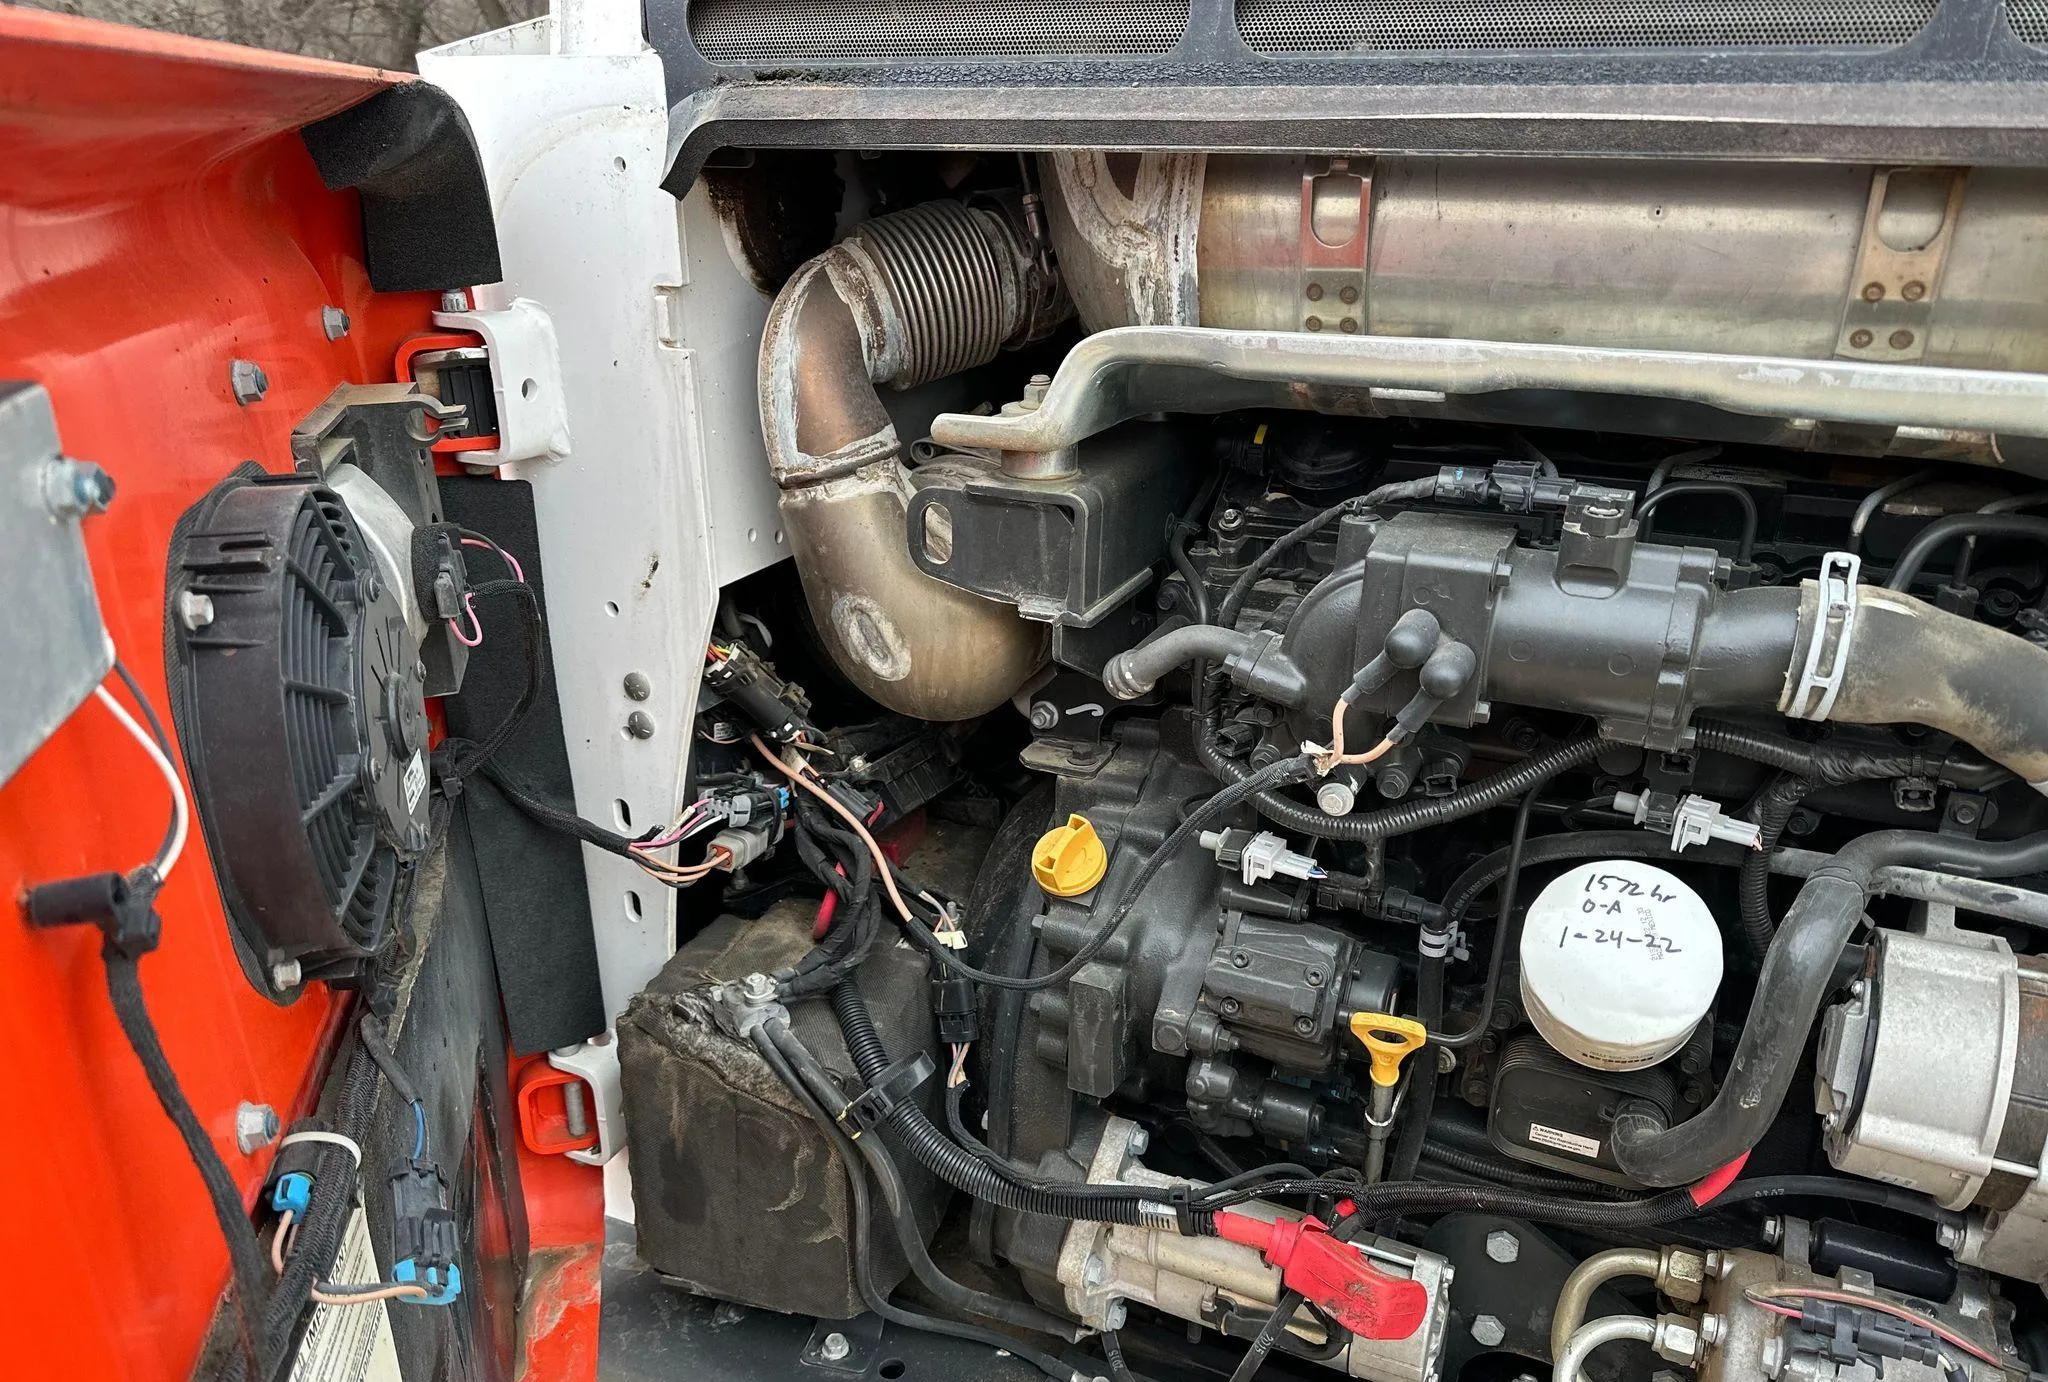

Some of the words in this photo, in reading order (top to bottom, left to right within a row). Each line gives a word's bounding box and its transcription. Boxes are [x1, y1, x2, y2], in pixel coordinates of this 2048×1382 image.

[1585, 874, 1644, 896] 1572
[1650, 884, 1677, 902] hr
[1560, 926, 1682, 953] 1-24-22
[305, 1241, 347, 1349] IMPOTANT
[1108, 1349, 1125, 1372] 2015
